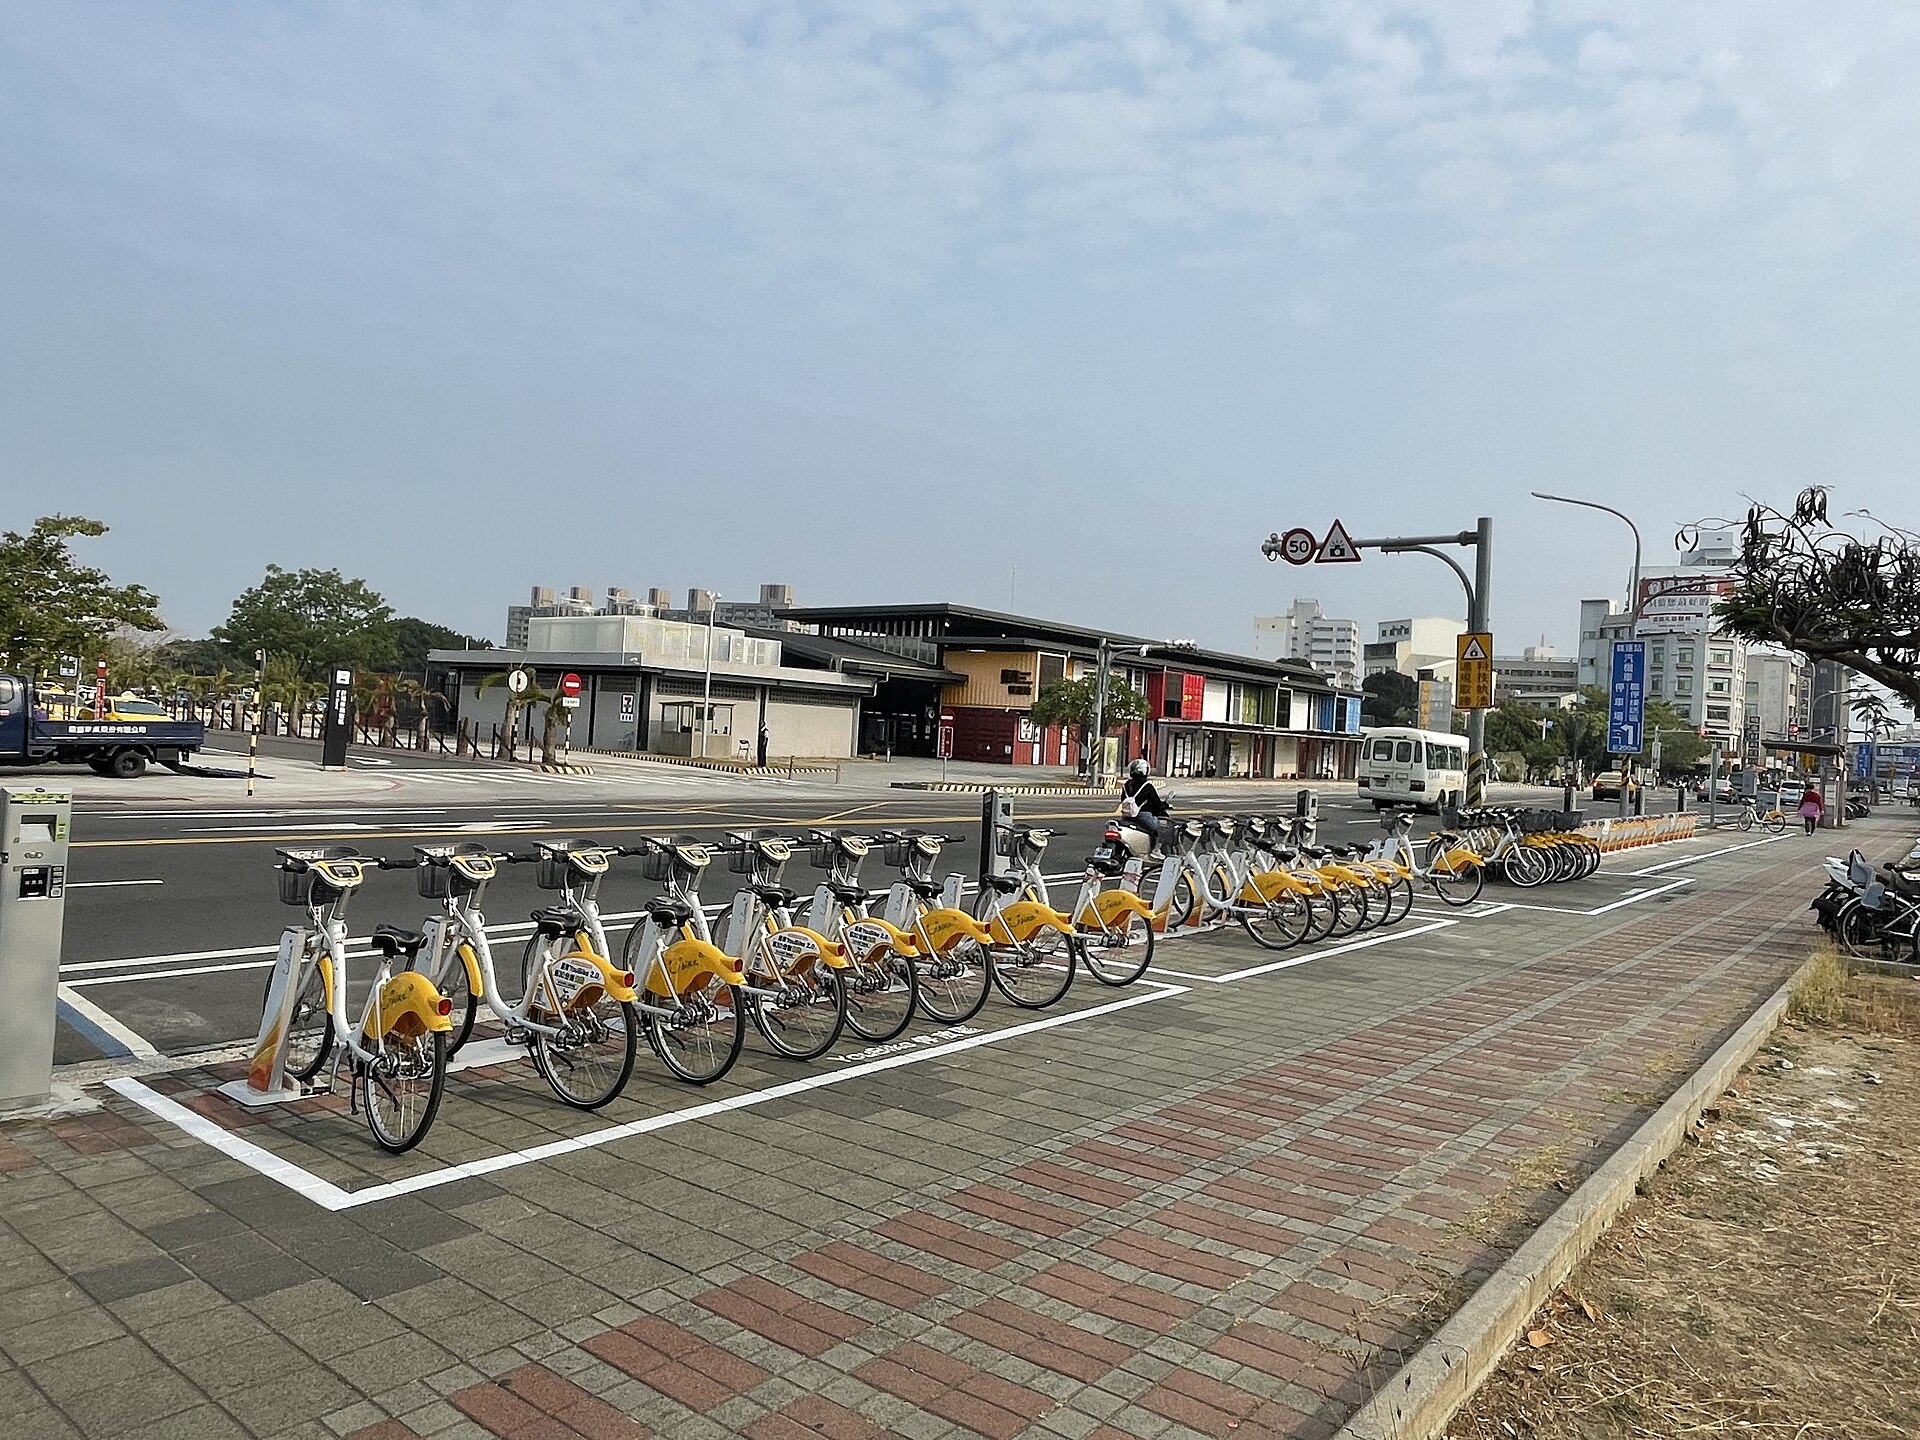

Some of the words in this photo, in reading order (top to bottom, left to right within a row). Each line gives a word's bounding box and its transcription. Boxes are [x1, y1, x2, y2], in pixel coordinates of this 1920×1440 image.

[1289, 540, 1309, 553] 50
[1623, 653, 1633, 682] 汽機車
[1614, 683, 1625, 721] 停車場
